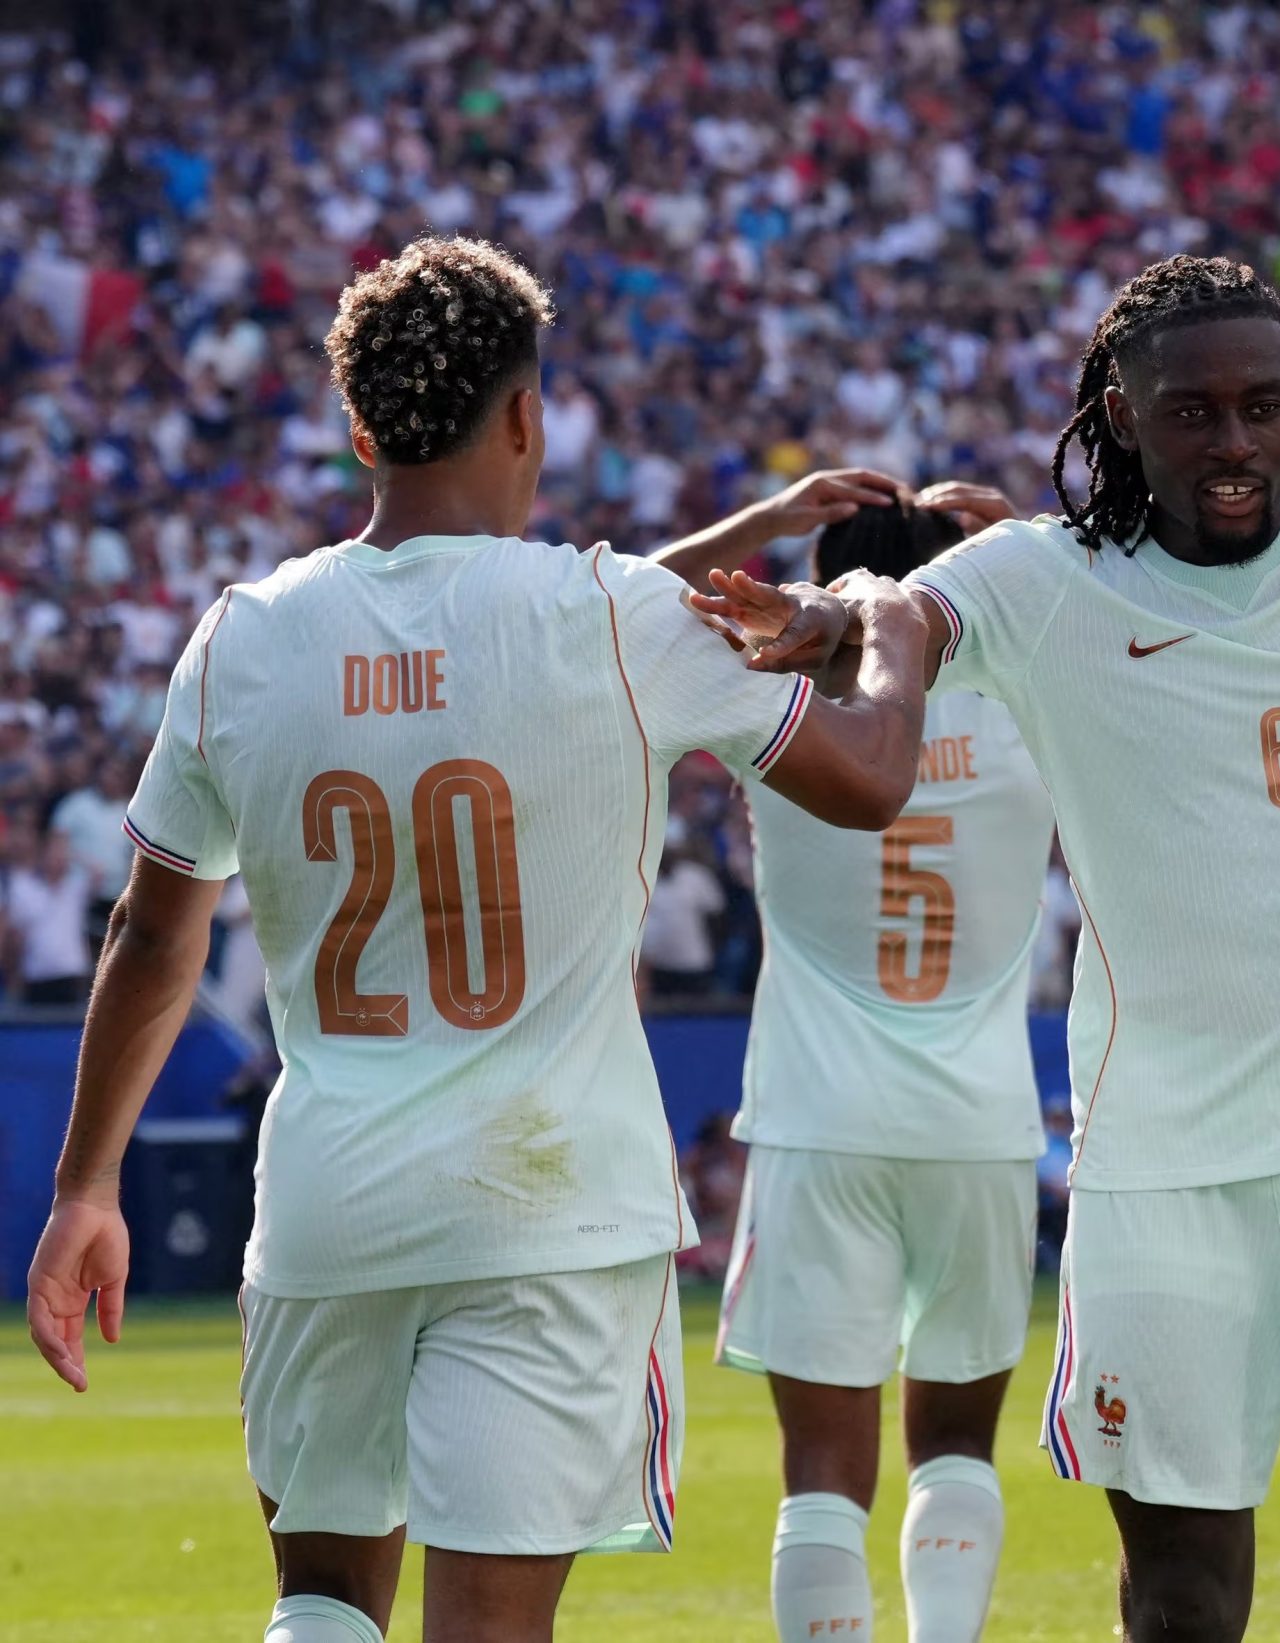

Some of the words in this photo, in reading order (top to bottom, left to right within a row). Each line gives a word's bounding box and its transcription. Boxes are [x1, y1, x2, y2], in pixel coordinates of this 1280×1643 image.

[343, 649, 446, 717] DOUE
[302, 759, 526, 1036] 20
[877, 816, 955, 1003] 5
[917, 1539, 976, 1552] FFF
[809, 1617, 863, 1637] FFF
